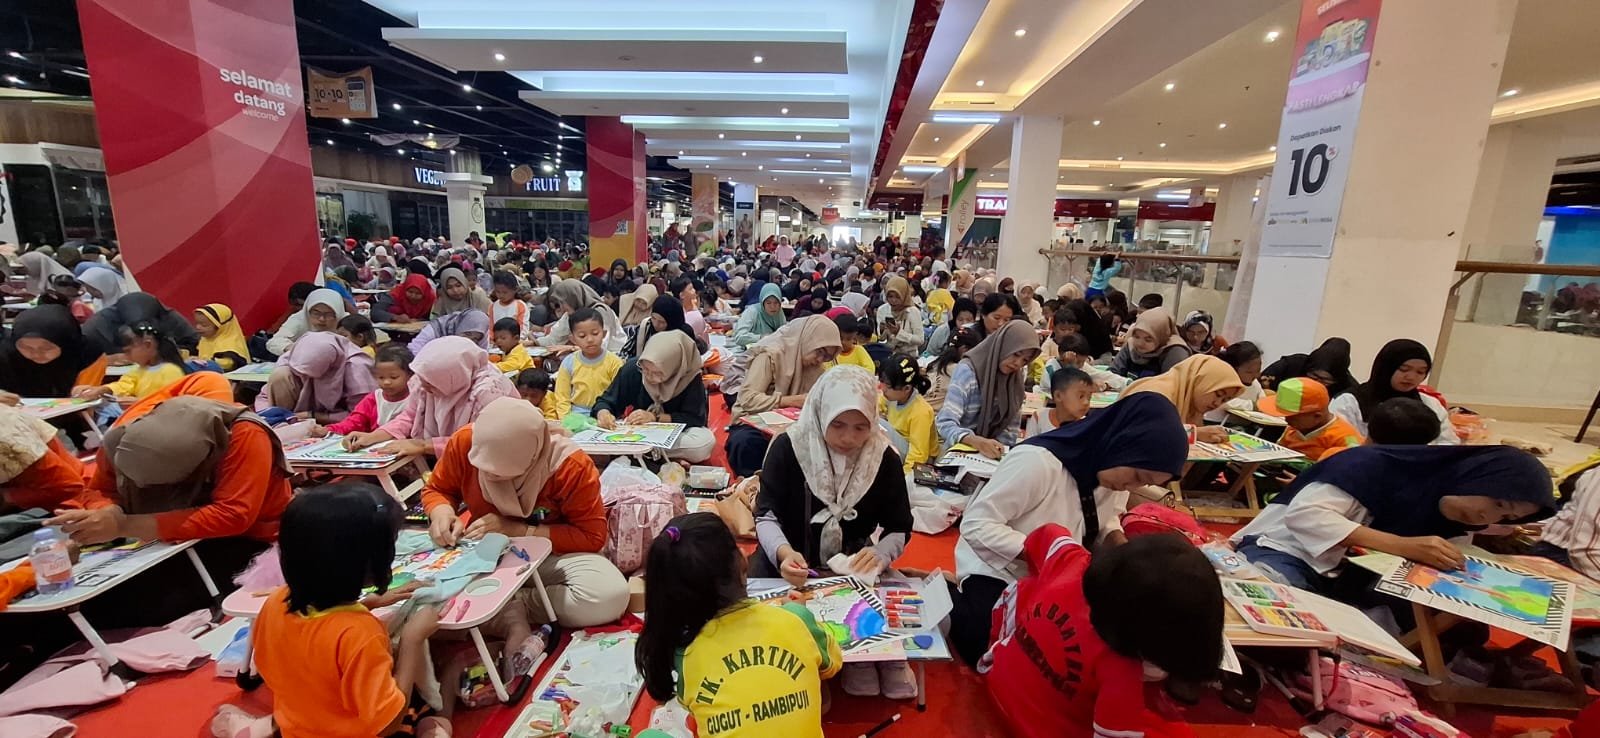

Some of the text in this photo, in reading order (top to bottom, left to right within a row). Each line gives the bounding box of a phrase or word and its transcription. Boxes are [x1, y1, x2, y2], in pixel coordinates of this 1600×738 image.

[220, 68, 292, 97] selamat
[234, 90, 285, 116] datang
[242, 108, 278, 121] welcome
[695, 645, 806, 705] TK. KARTINI
[706, 708, 741, 735] GUGUT
